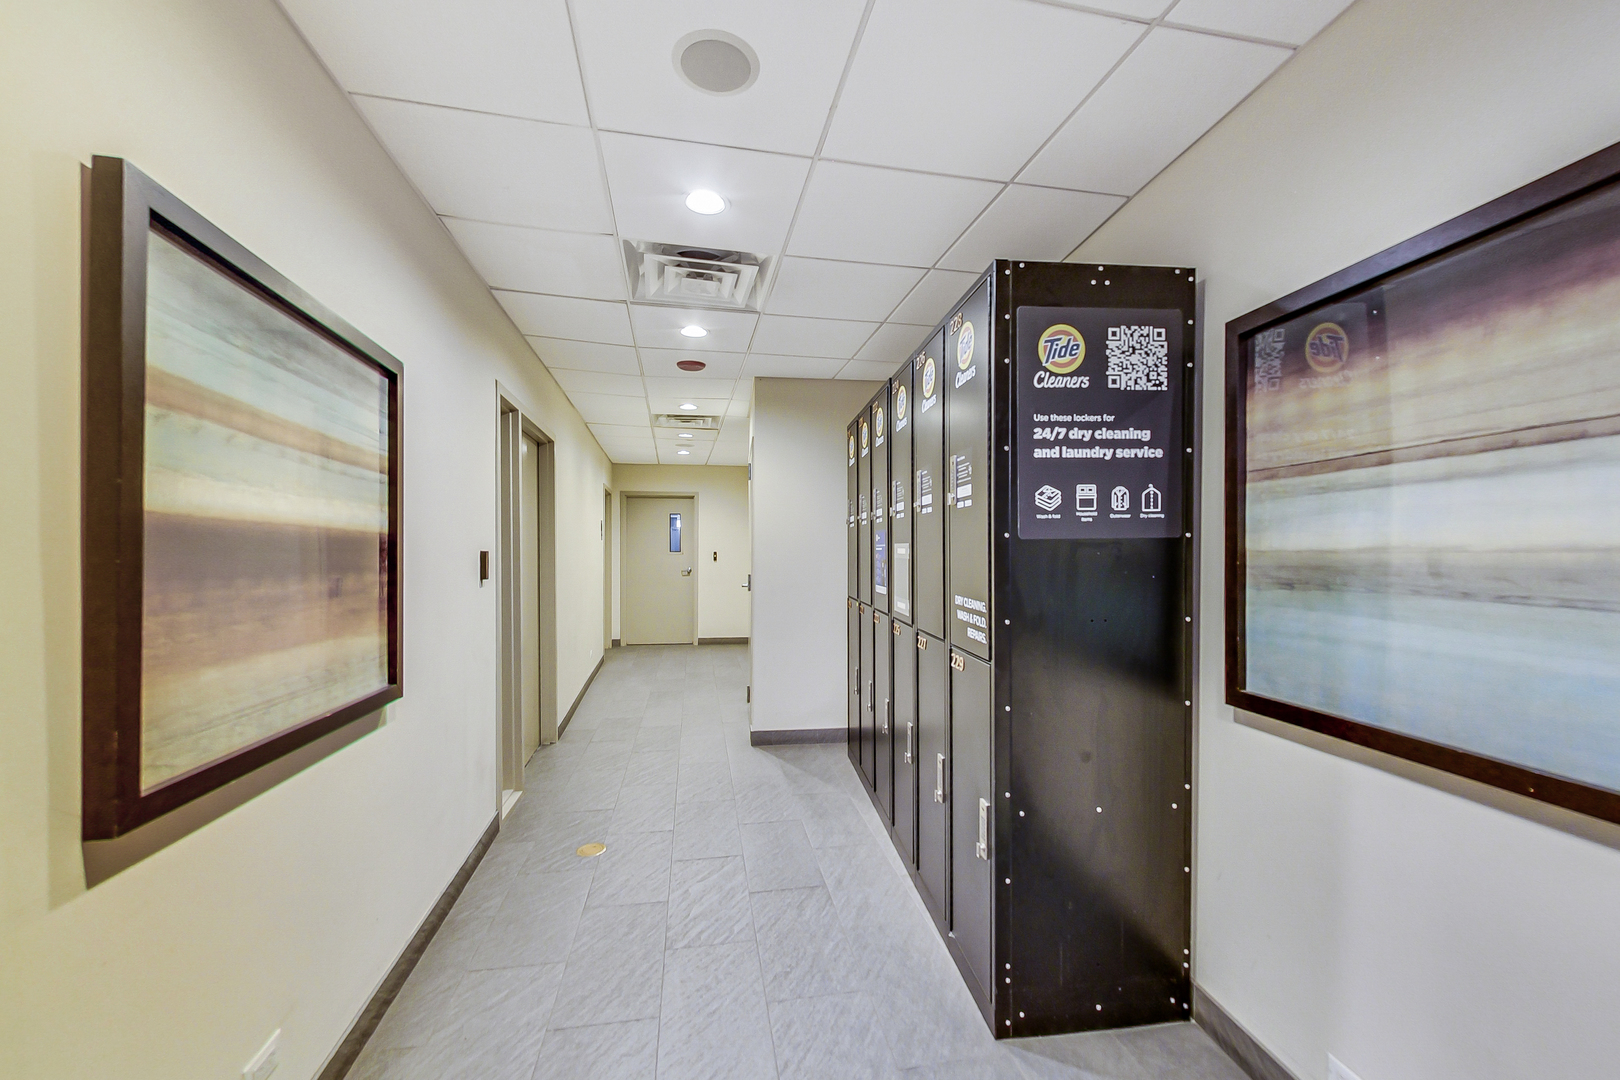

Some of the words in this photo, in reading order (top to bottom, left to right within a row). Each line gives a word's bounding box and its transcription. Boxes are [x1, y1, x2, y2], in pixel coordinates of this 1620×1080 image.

[950, 313, 963, 336] 228
[1042, 335, 1082, 366] Tide
[1033, 371, 1090, 388] Cleaners
[1033, 414, 1049, 422] Use
[1050, 413, 1072, 422] these
[1073, 413, 1102, 422] lockers
[1103, 413, 1115, 422] for
[1033, 426, 1067, 441] 24/7
[1068, 427, 1093, 441] dry
[1094, 427, 1151, 441] cleaning
[1033, 446, 1060, 458] and
[1061, 446, 1114, 460] laundry
[1115, 446, 1164, 458] service
[955, 594, 963, 606] DRY
[956, 609, 969, 622] WASH
[951, 653, 965, 672] 229
